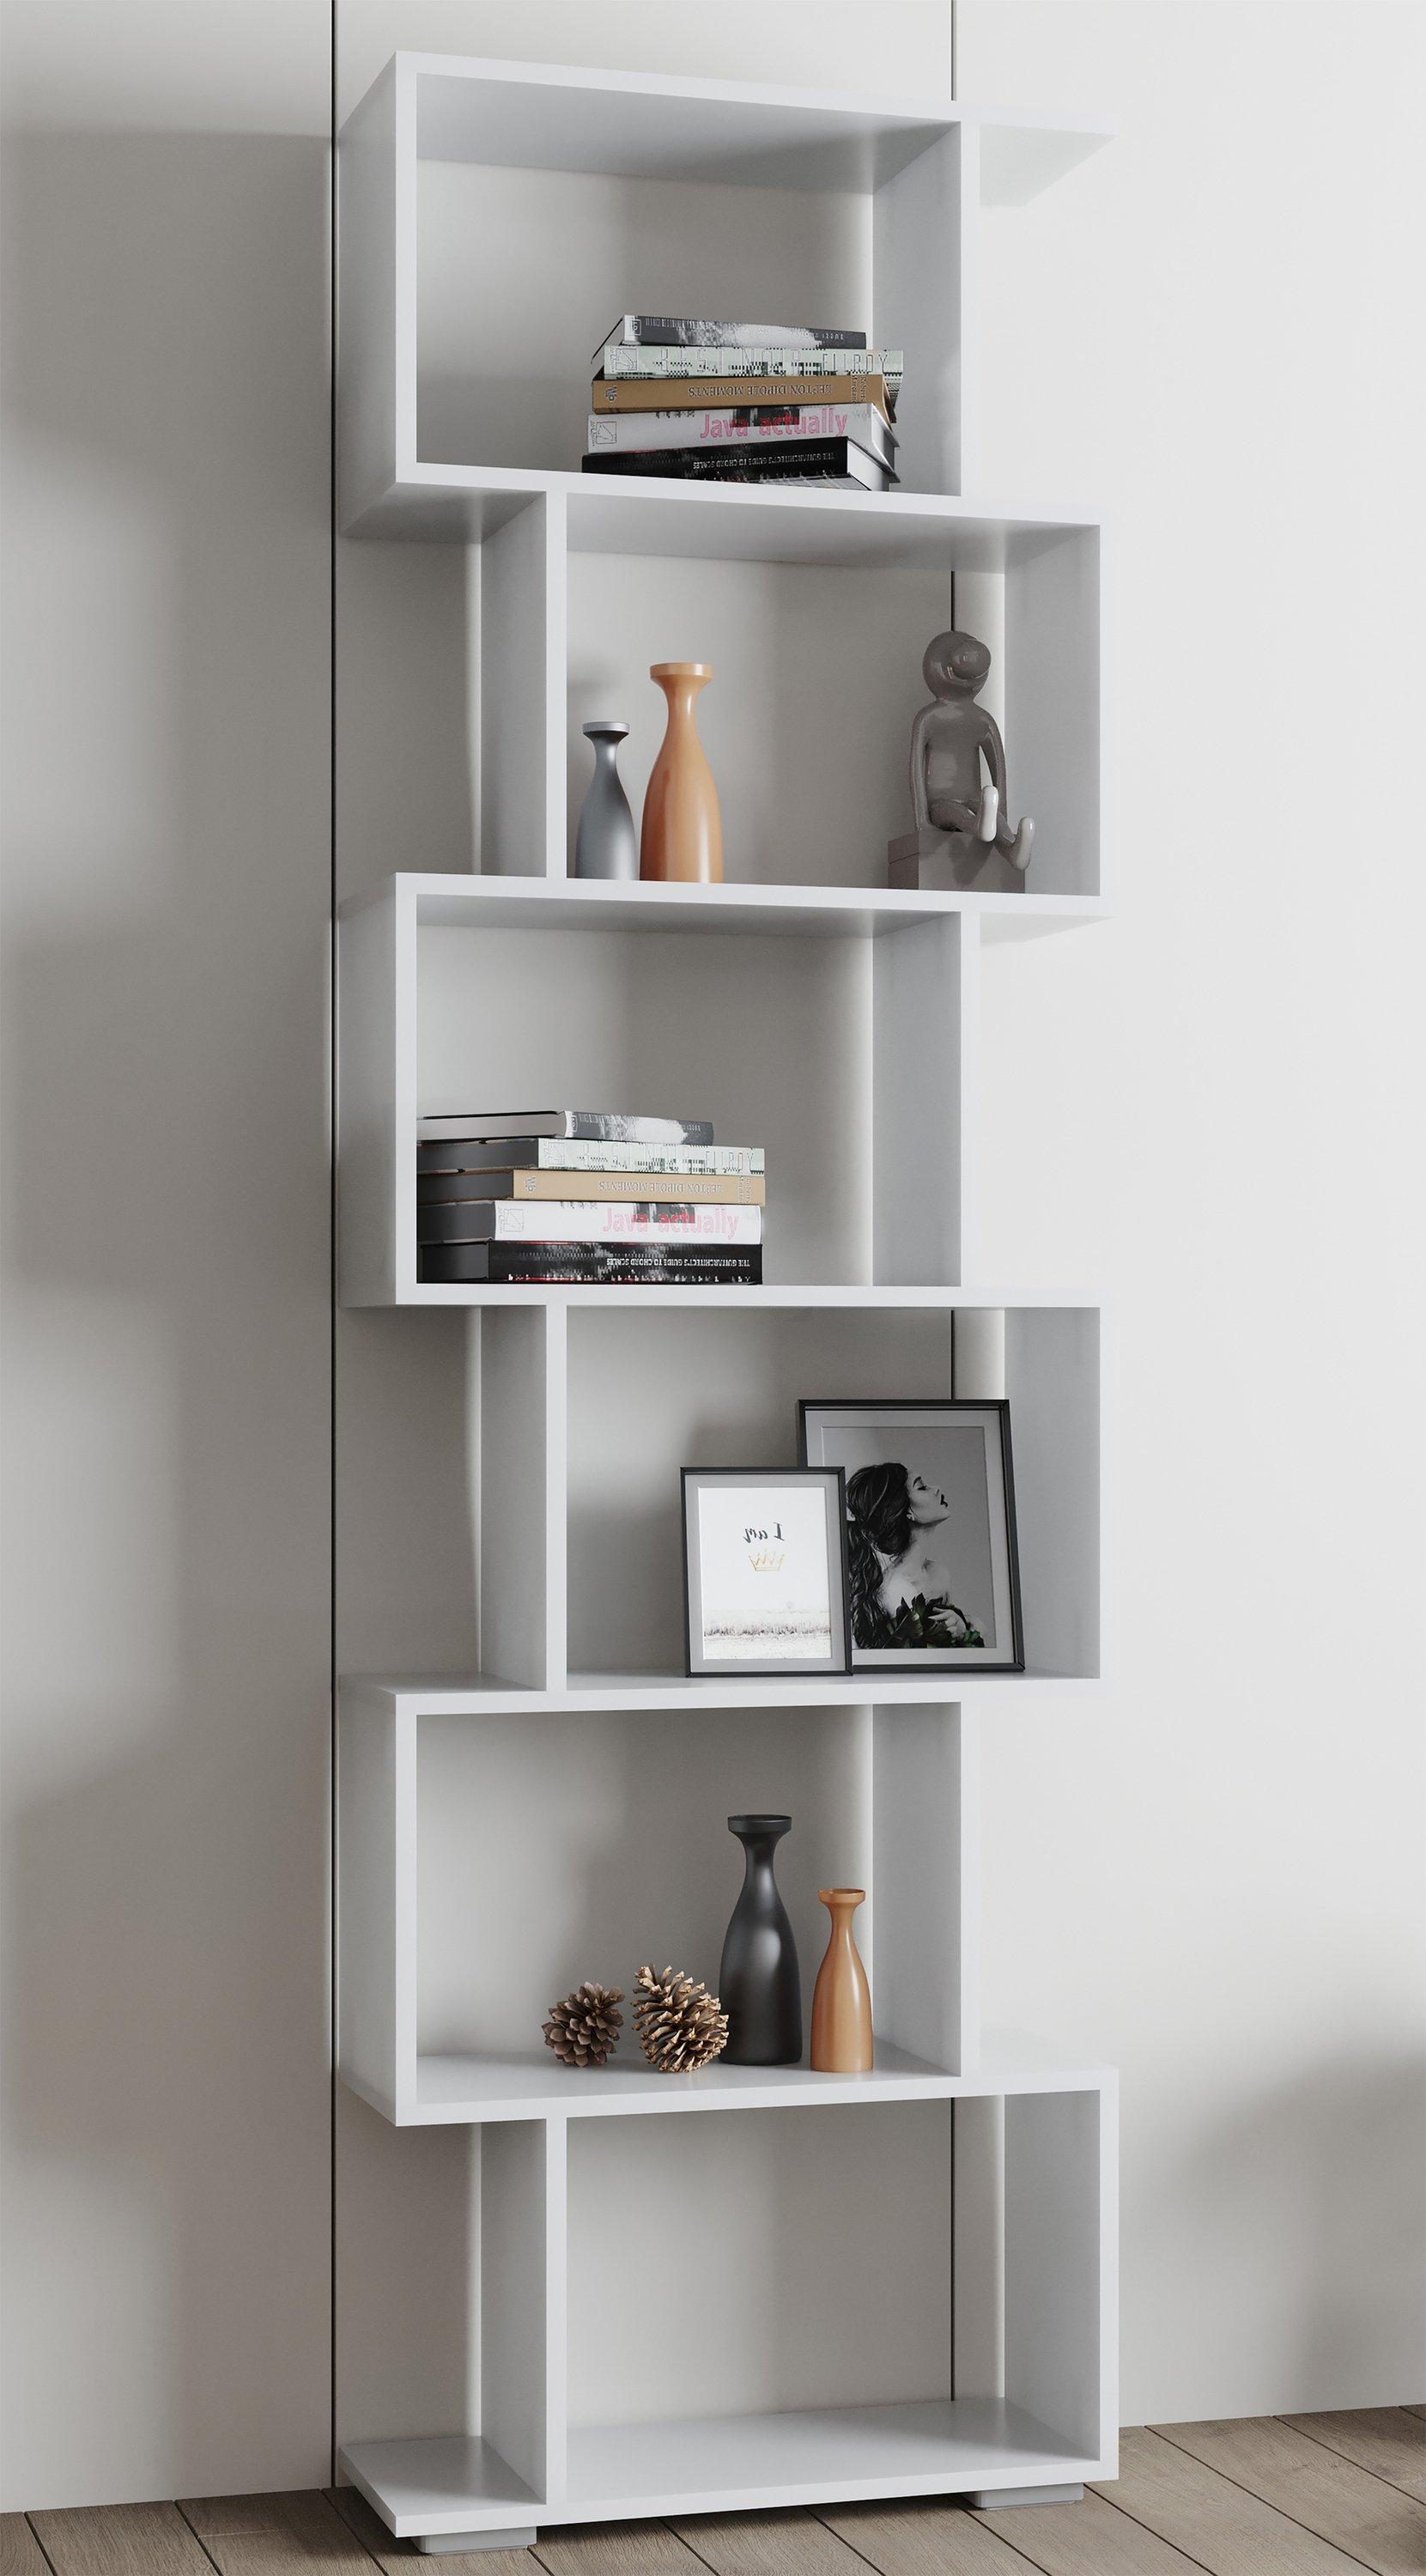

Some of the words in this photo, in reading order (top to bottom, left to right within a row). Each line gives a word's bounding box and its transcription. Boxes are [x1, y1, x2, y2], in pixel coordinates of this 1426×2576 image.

[687, 386, 744, 398] MOMENTS
[747, 385, 786, 397] DIPOLE
[790, 384, 833, 397] LEPTON
[700, 412, 748, 439] Java
[759, 407, 848, 437] actually
[692, 460, 715, 470] SCALES
[715, 459, 738, 468] CHORD
[749, 457, 768, 465] GUIDE
[598, 1181, 648, 1194] MOMENTS
[650, 1182, 684, 1194] DIPOLE
[686, 1182, 723, 1195] LEPTON
[603, 1206, 648, 1232] Java
[658, 1207, 739, 1240] actually
[607, 1257, 629, 1267] SCALES
[631, 1257, 652, 1267] CHORD
[653, 1257, 663, 1267] TO
[663, 1257, 683, 1267] GUIDE
[737, 1257, 750, 1267] THE
